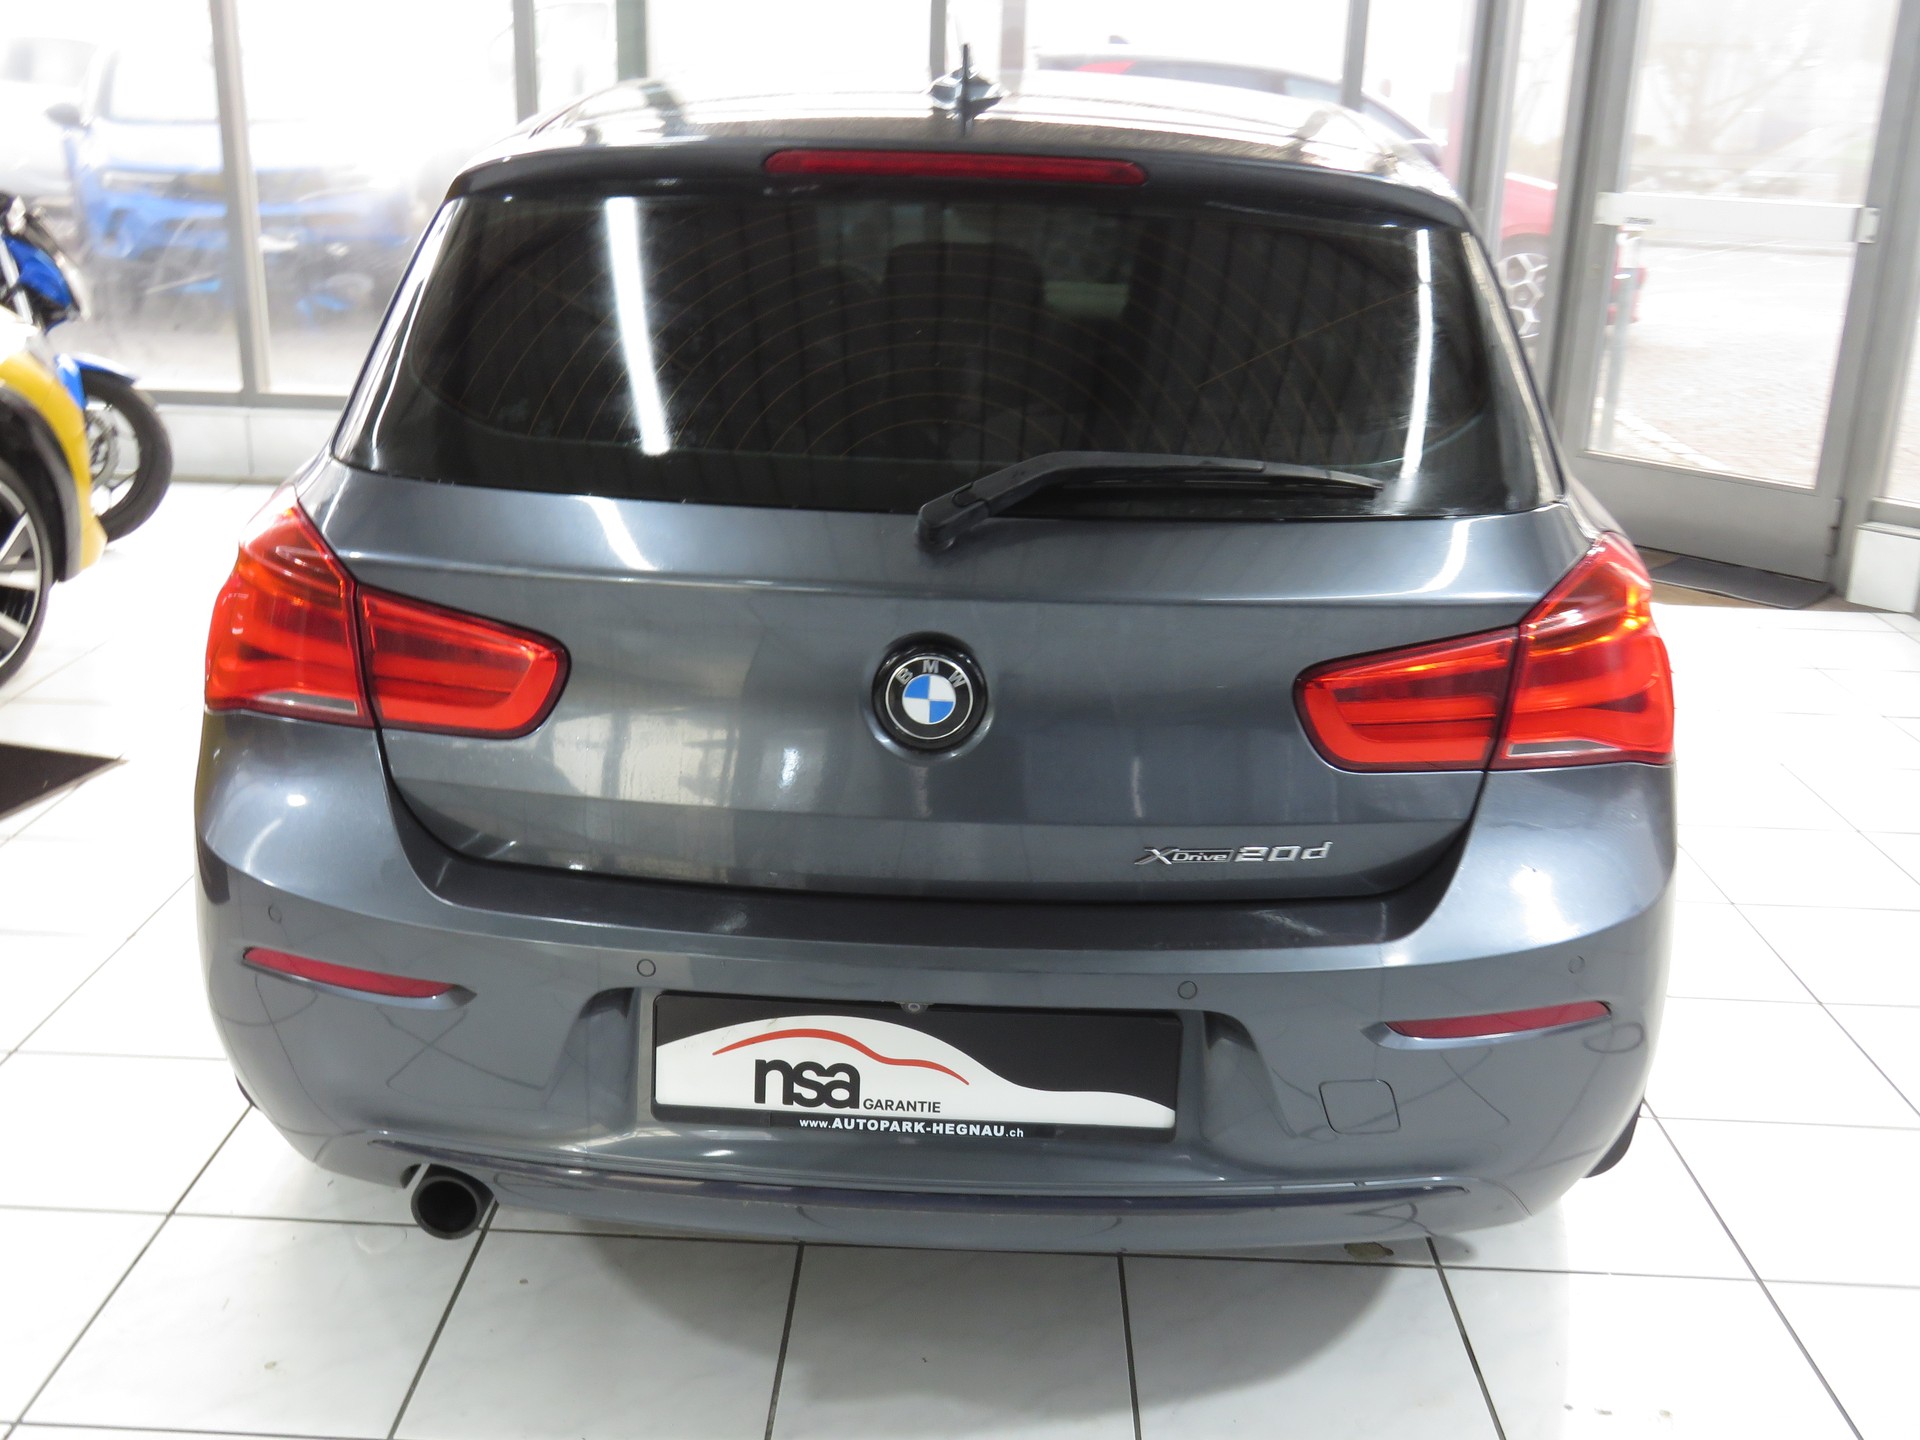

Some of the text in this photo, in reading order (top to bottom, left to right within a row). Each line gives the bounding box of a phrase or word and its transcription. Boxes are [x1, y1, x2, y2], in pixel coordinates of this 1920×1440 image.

[895, 659, 966, 688] BMW
[1235, 841, 1333, 862] 20d
[754, 1059, 941, 1114] nsa GARANTIE
[799, 1117, 1024, 1138] www.AUTOPARK-HEGNAU.ch
